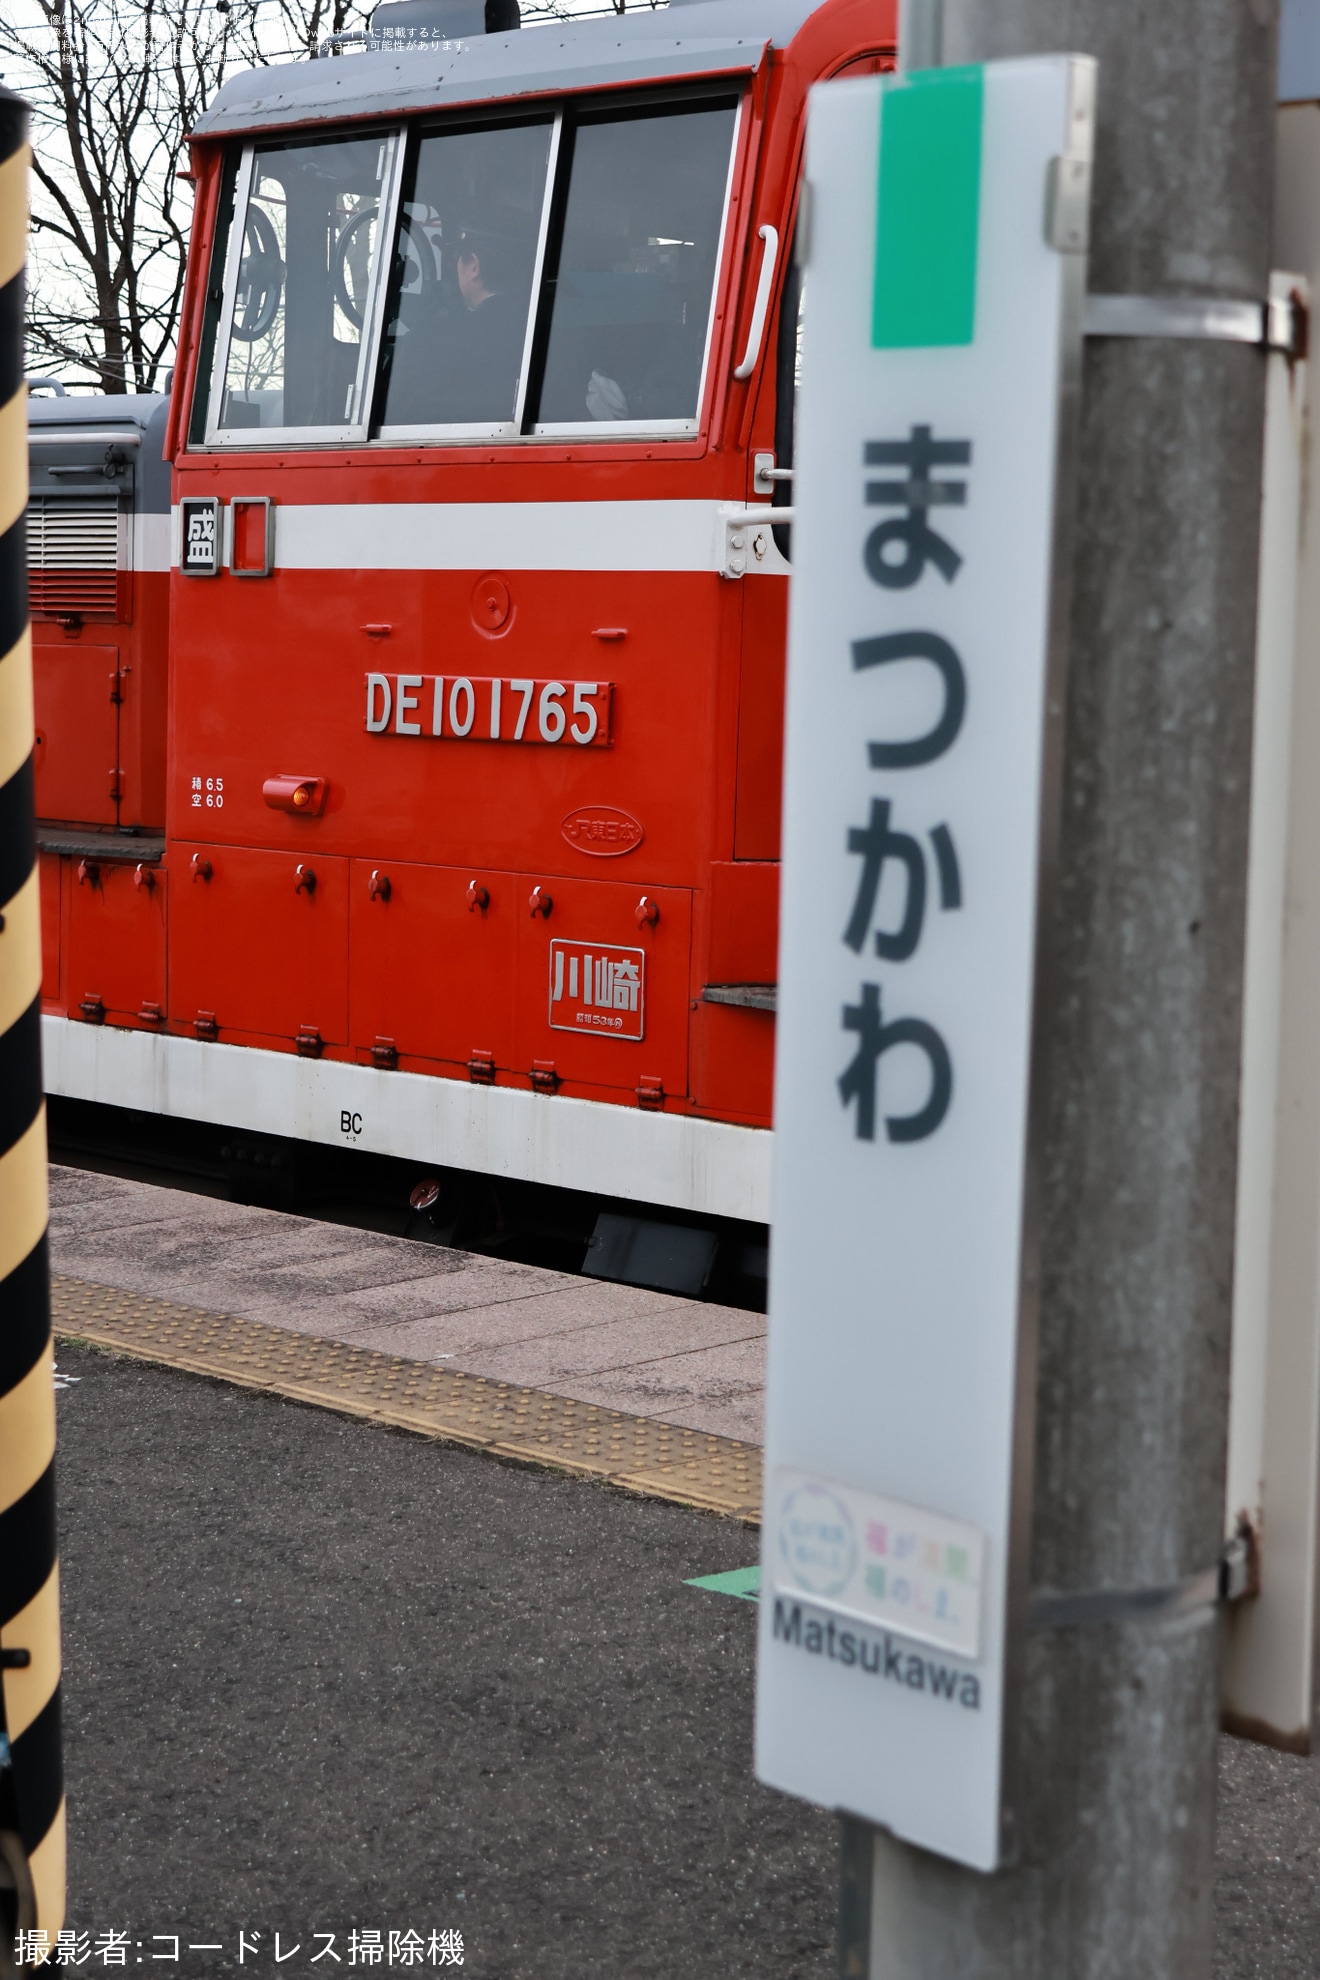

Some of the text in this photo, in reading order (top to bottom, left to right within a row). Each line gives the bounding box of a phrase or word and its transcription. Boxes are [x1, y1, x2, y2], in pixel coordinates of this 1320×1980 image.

[838, 423, 972, 1145] まつかわ
[552, 950, 641, 1012] 川崎
[341, 1110, 363, 1135] BC
[773, 1596, 981, 1711] Matsukawa
